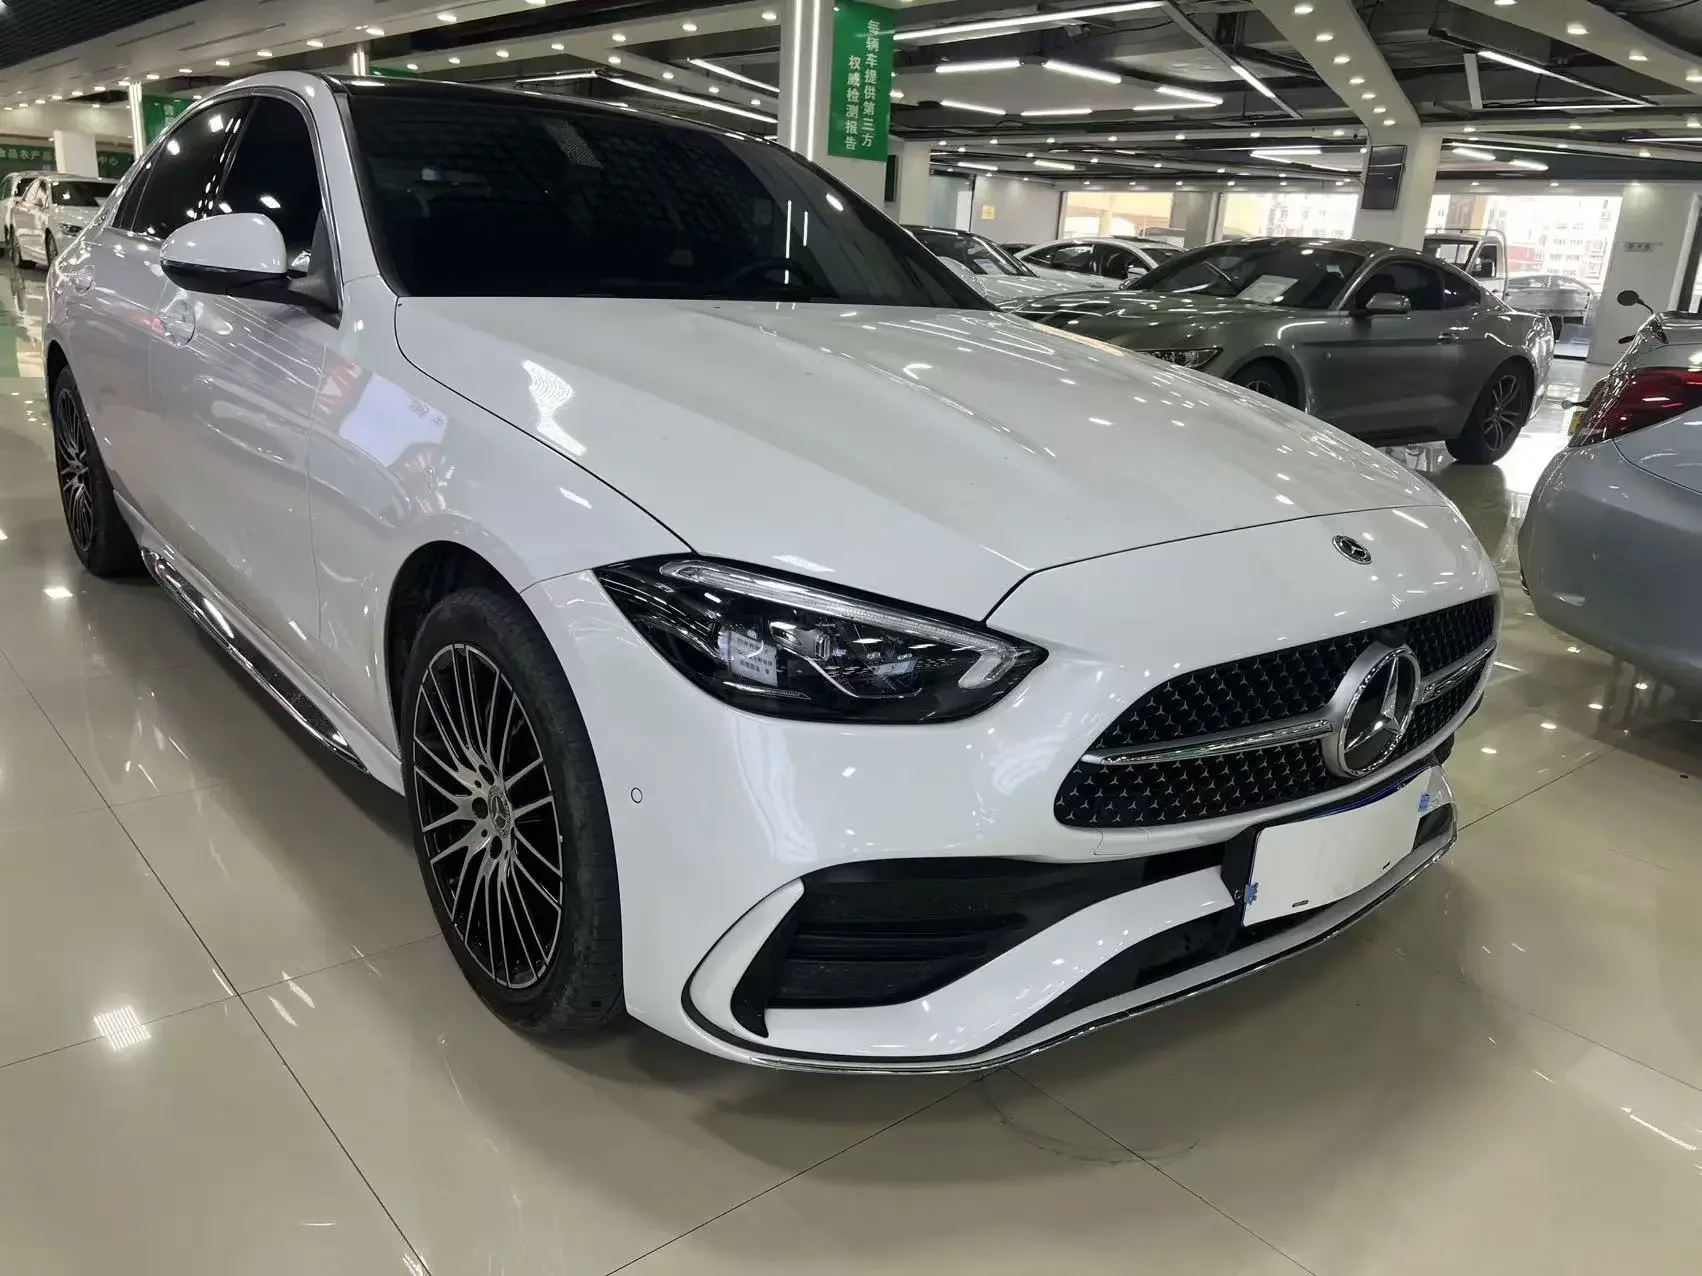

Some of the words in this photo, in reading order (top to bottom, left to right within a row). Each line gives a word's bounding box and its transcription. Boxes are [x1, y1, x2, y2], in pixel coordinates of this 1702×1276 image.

[844, 55, 861, 150] 权威检测报告
[862, 20, 880, 147] 每辆车提供第三方
